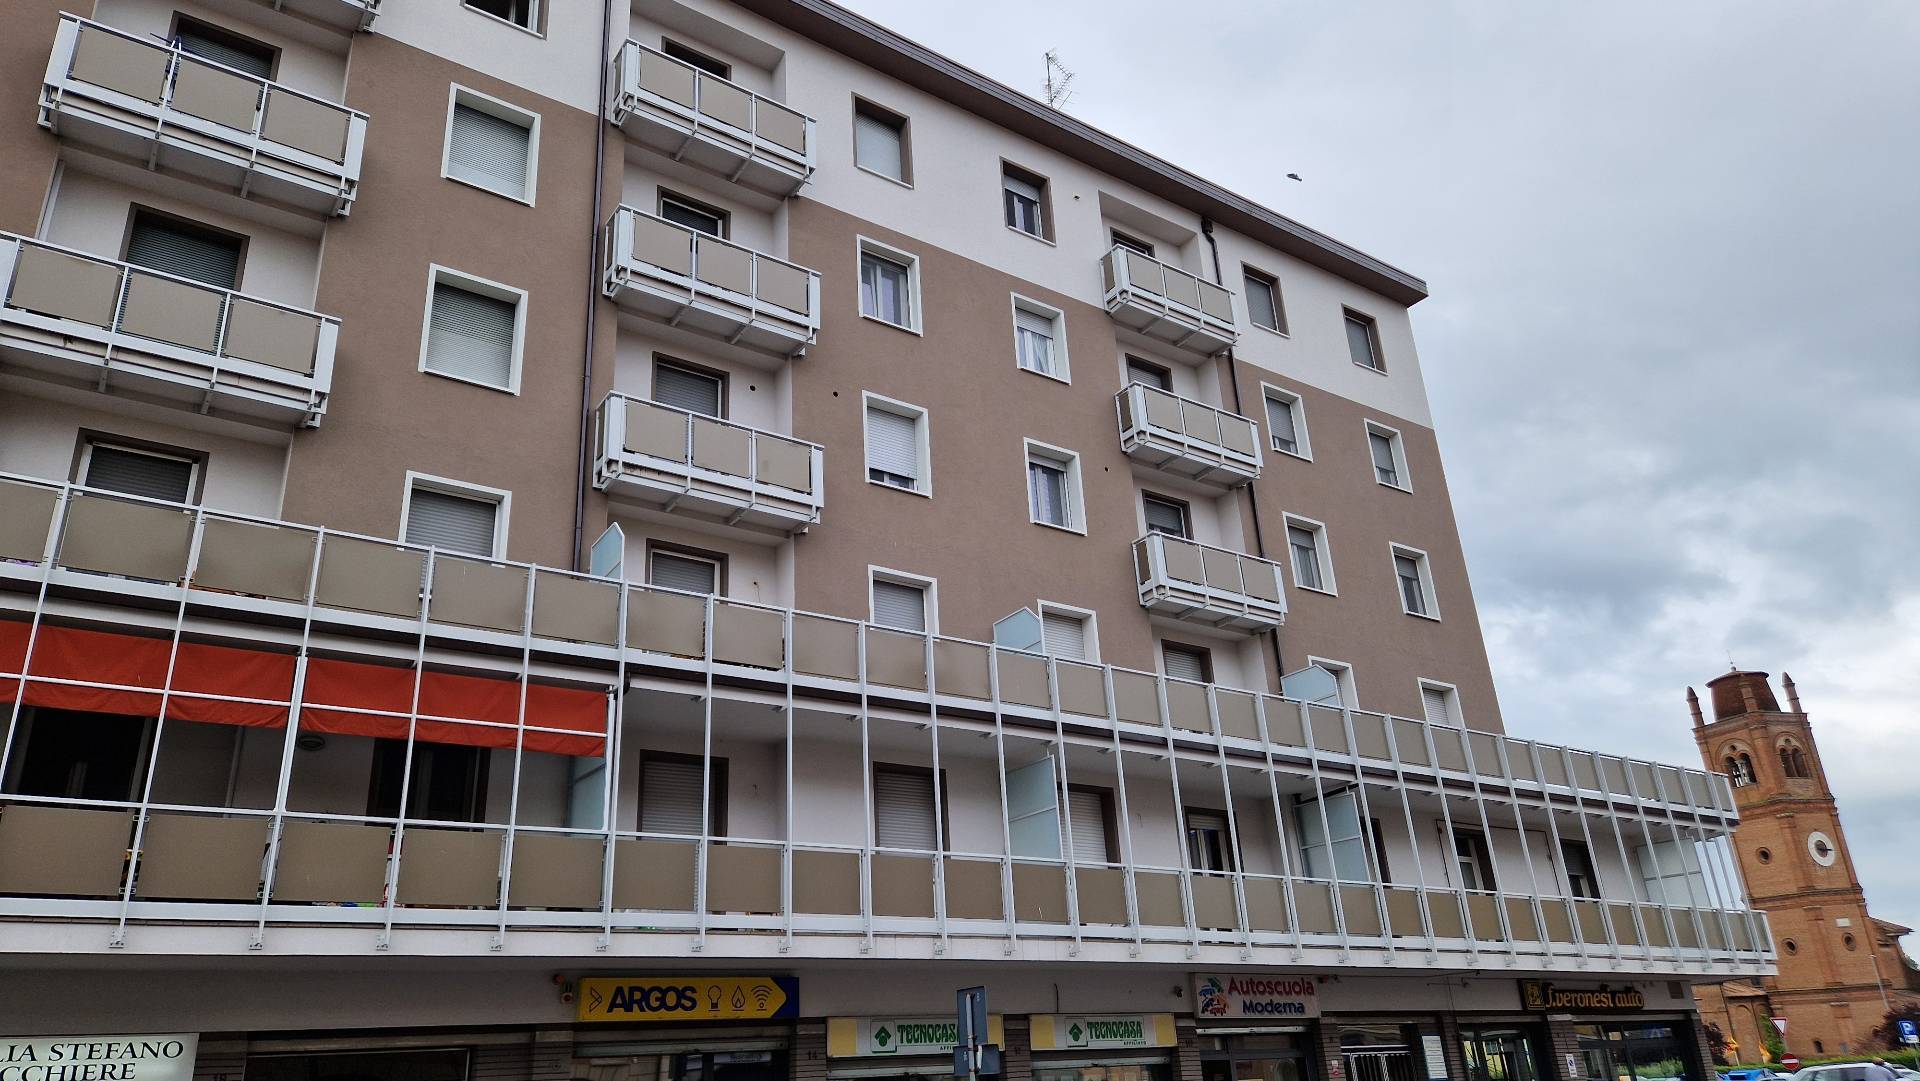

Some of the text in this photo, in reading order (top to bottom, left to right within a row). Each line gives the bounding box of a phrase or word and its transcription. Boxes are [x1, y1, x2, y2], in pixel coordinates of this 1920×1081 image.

[1228, 976, 1315, 996] Autoscuola
[606, 985, 698, 1013] ARGOS
[1242, 999, 1305, 1014] Moderna
[897, 1023, 960, 1044] TECNOCAS
[1087, 1021, 1143, 1039] TECNOCASA
[0, 1041, 184, 1062] IA STEFANO
